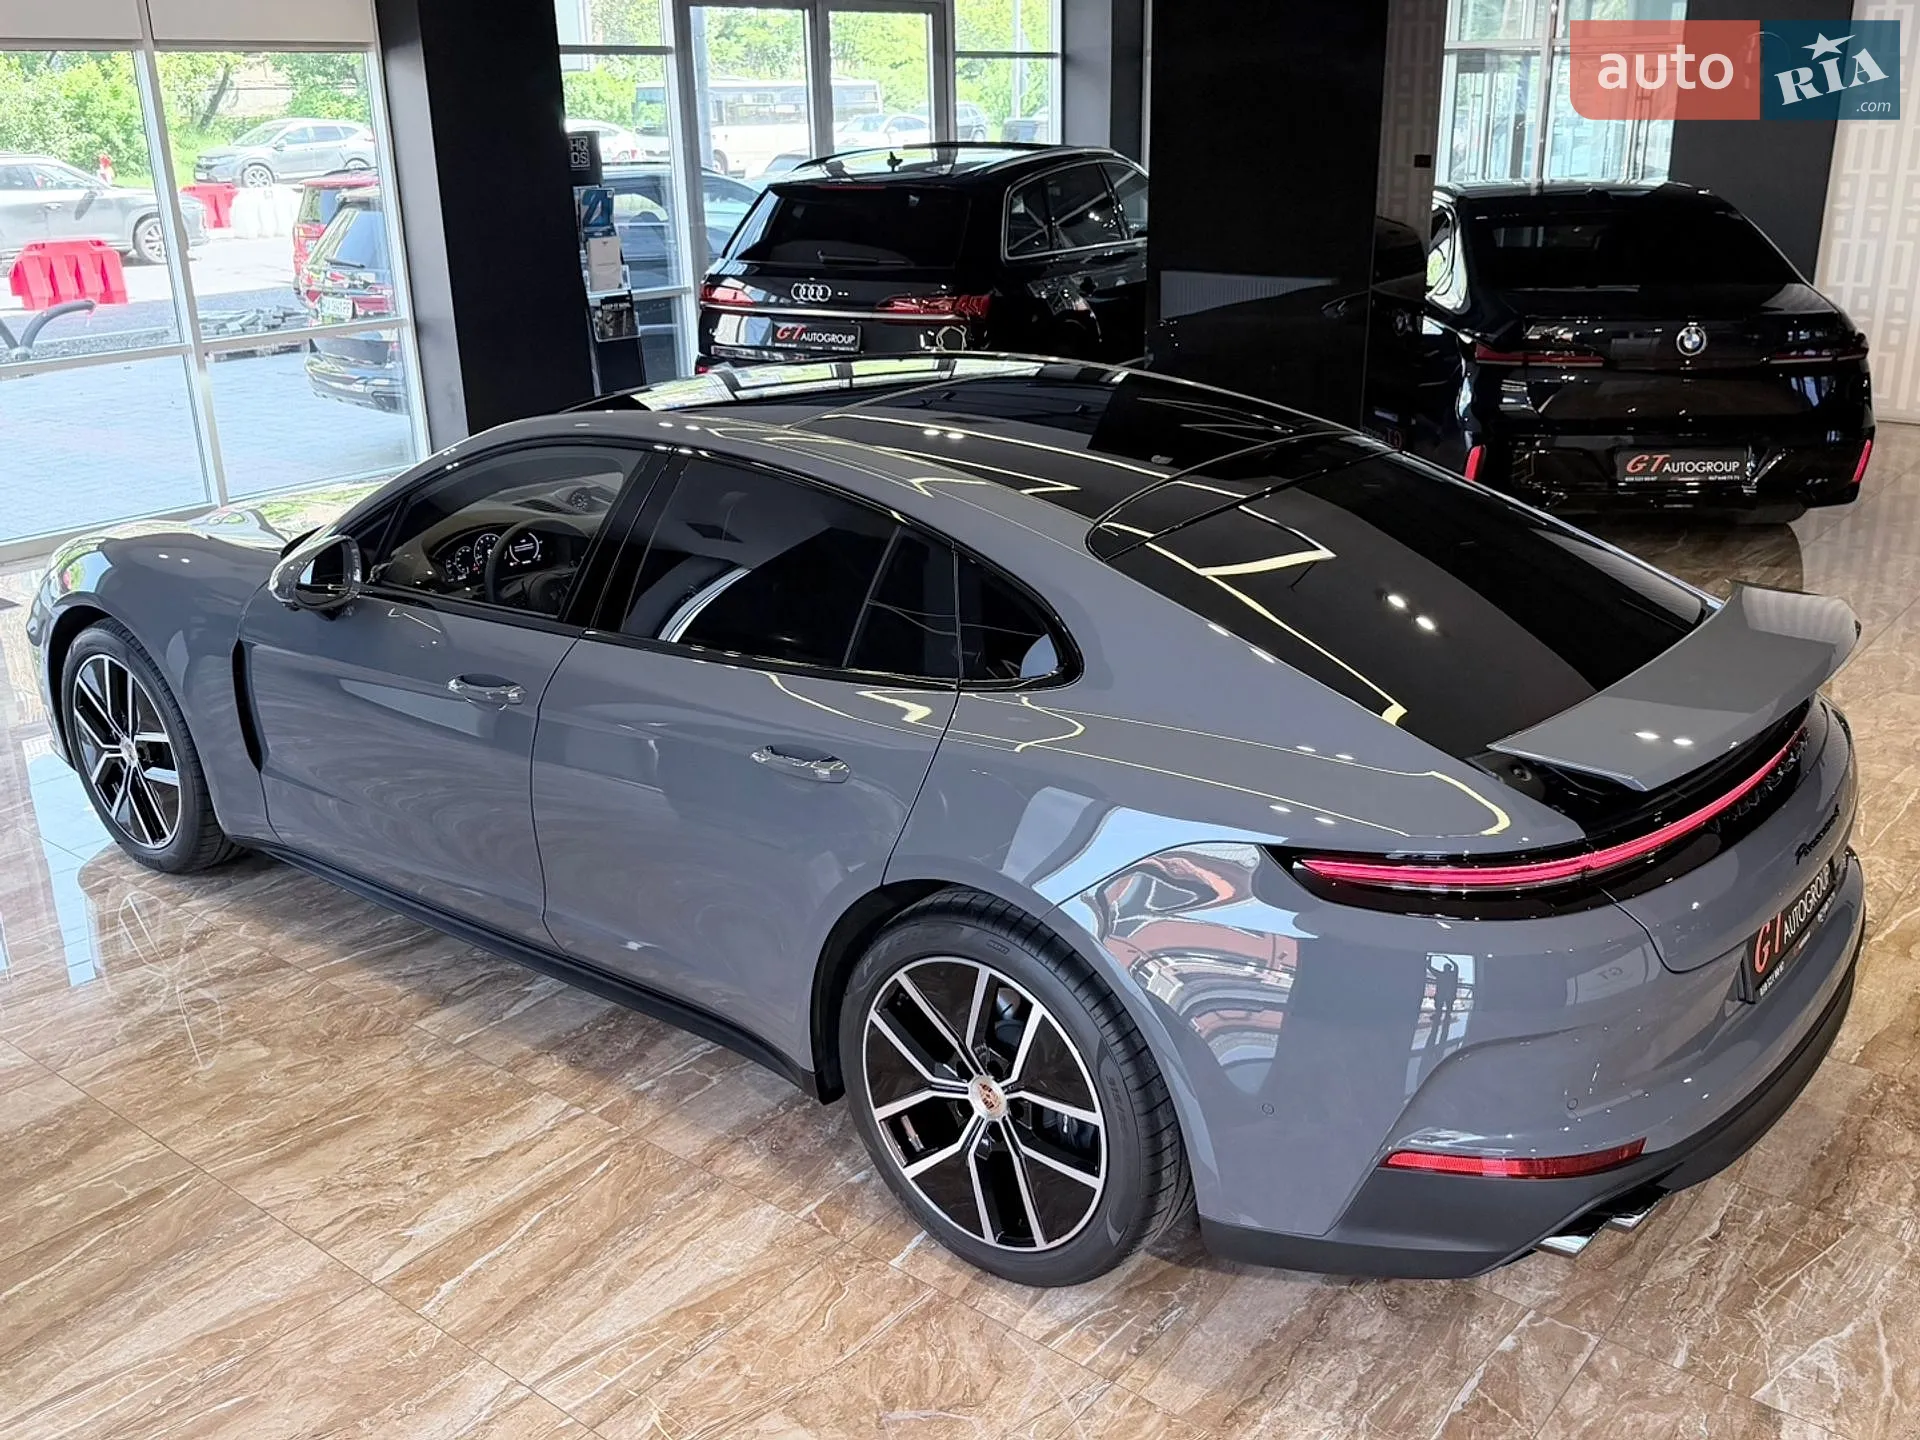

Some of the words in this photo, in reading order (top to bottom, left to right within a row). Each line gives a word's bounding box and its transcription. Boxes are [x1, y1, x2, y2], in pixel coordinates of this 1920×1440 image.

[570, 139, 588, 152] HQ
[776, 324, 808, 340] GT
[800, 332, 856, 344] AUTOGROUP
[1626, 454, 1671, 473] GT
[1662, 461, 1740, 473] AUTOGROUP
[1783, 863, 1832, 945] AUTOGROUP
